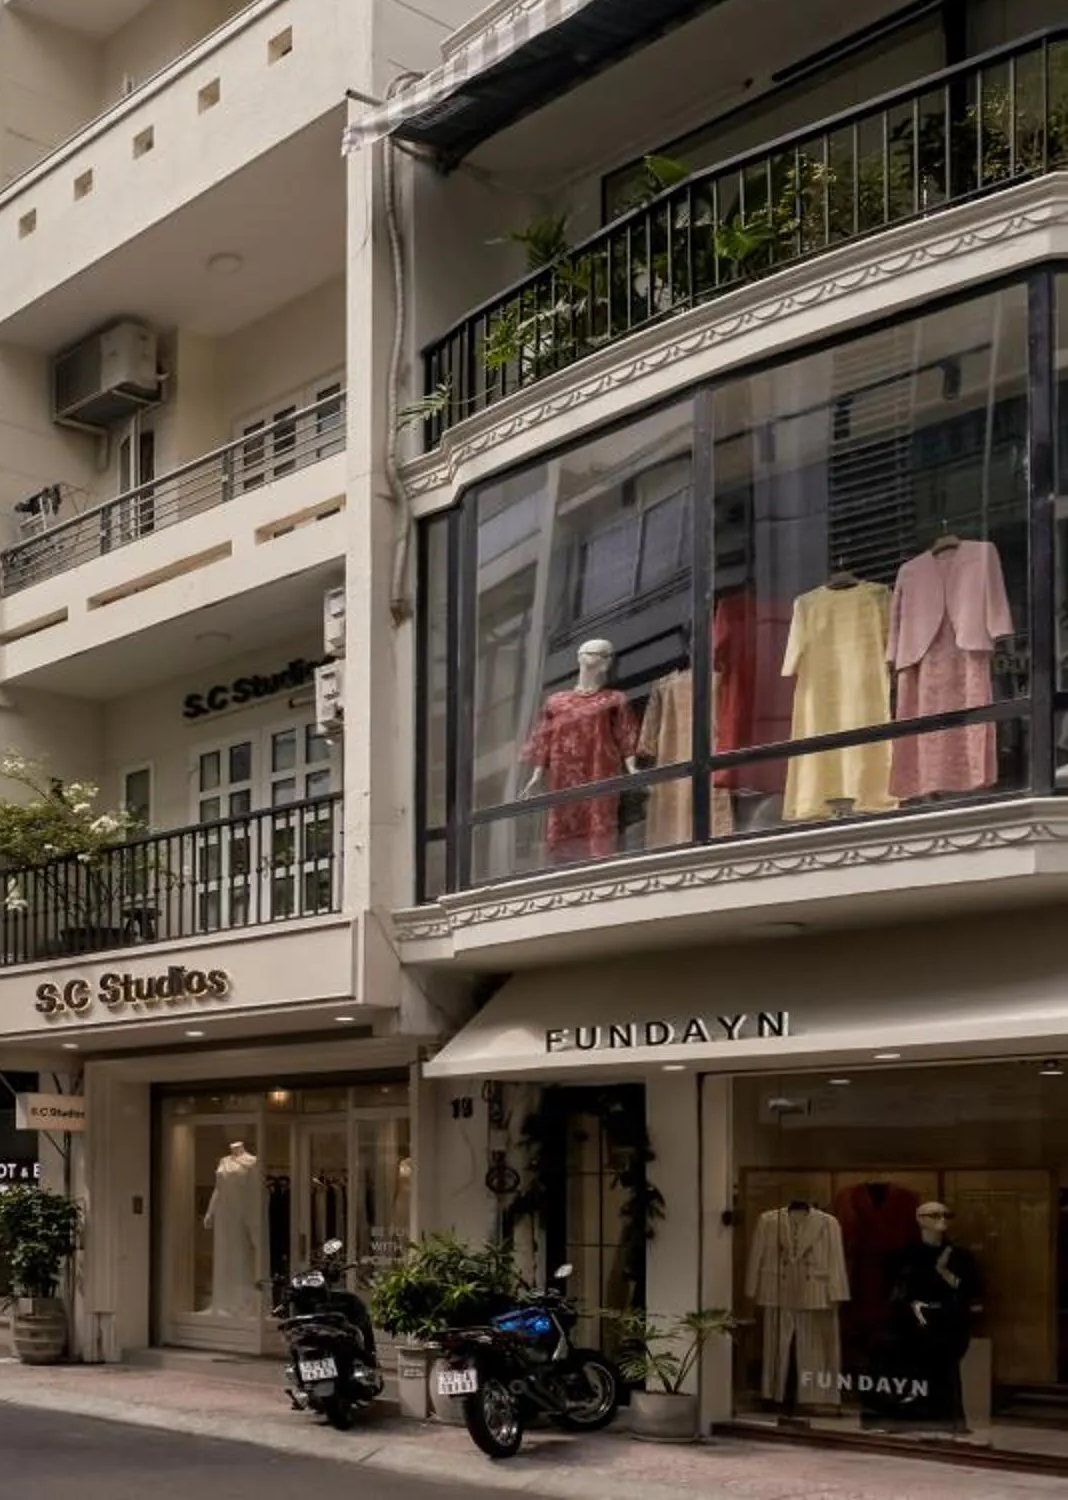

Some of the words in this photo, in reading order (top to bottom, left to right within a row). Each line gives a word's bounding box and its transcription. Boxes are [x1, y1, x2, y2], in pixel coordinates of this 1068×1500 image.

[35, 982, 91, 1013] S.C
[97, 964, 230, 1004] Studios
[545, 1010, 790, 1053] FUNDAYN
[800, 1370, 930, 1398] FUNDAYN
